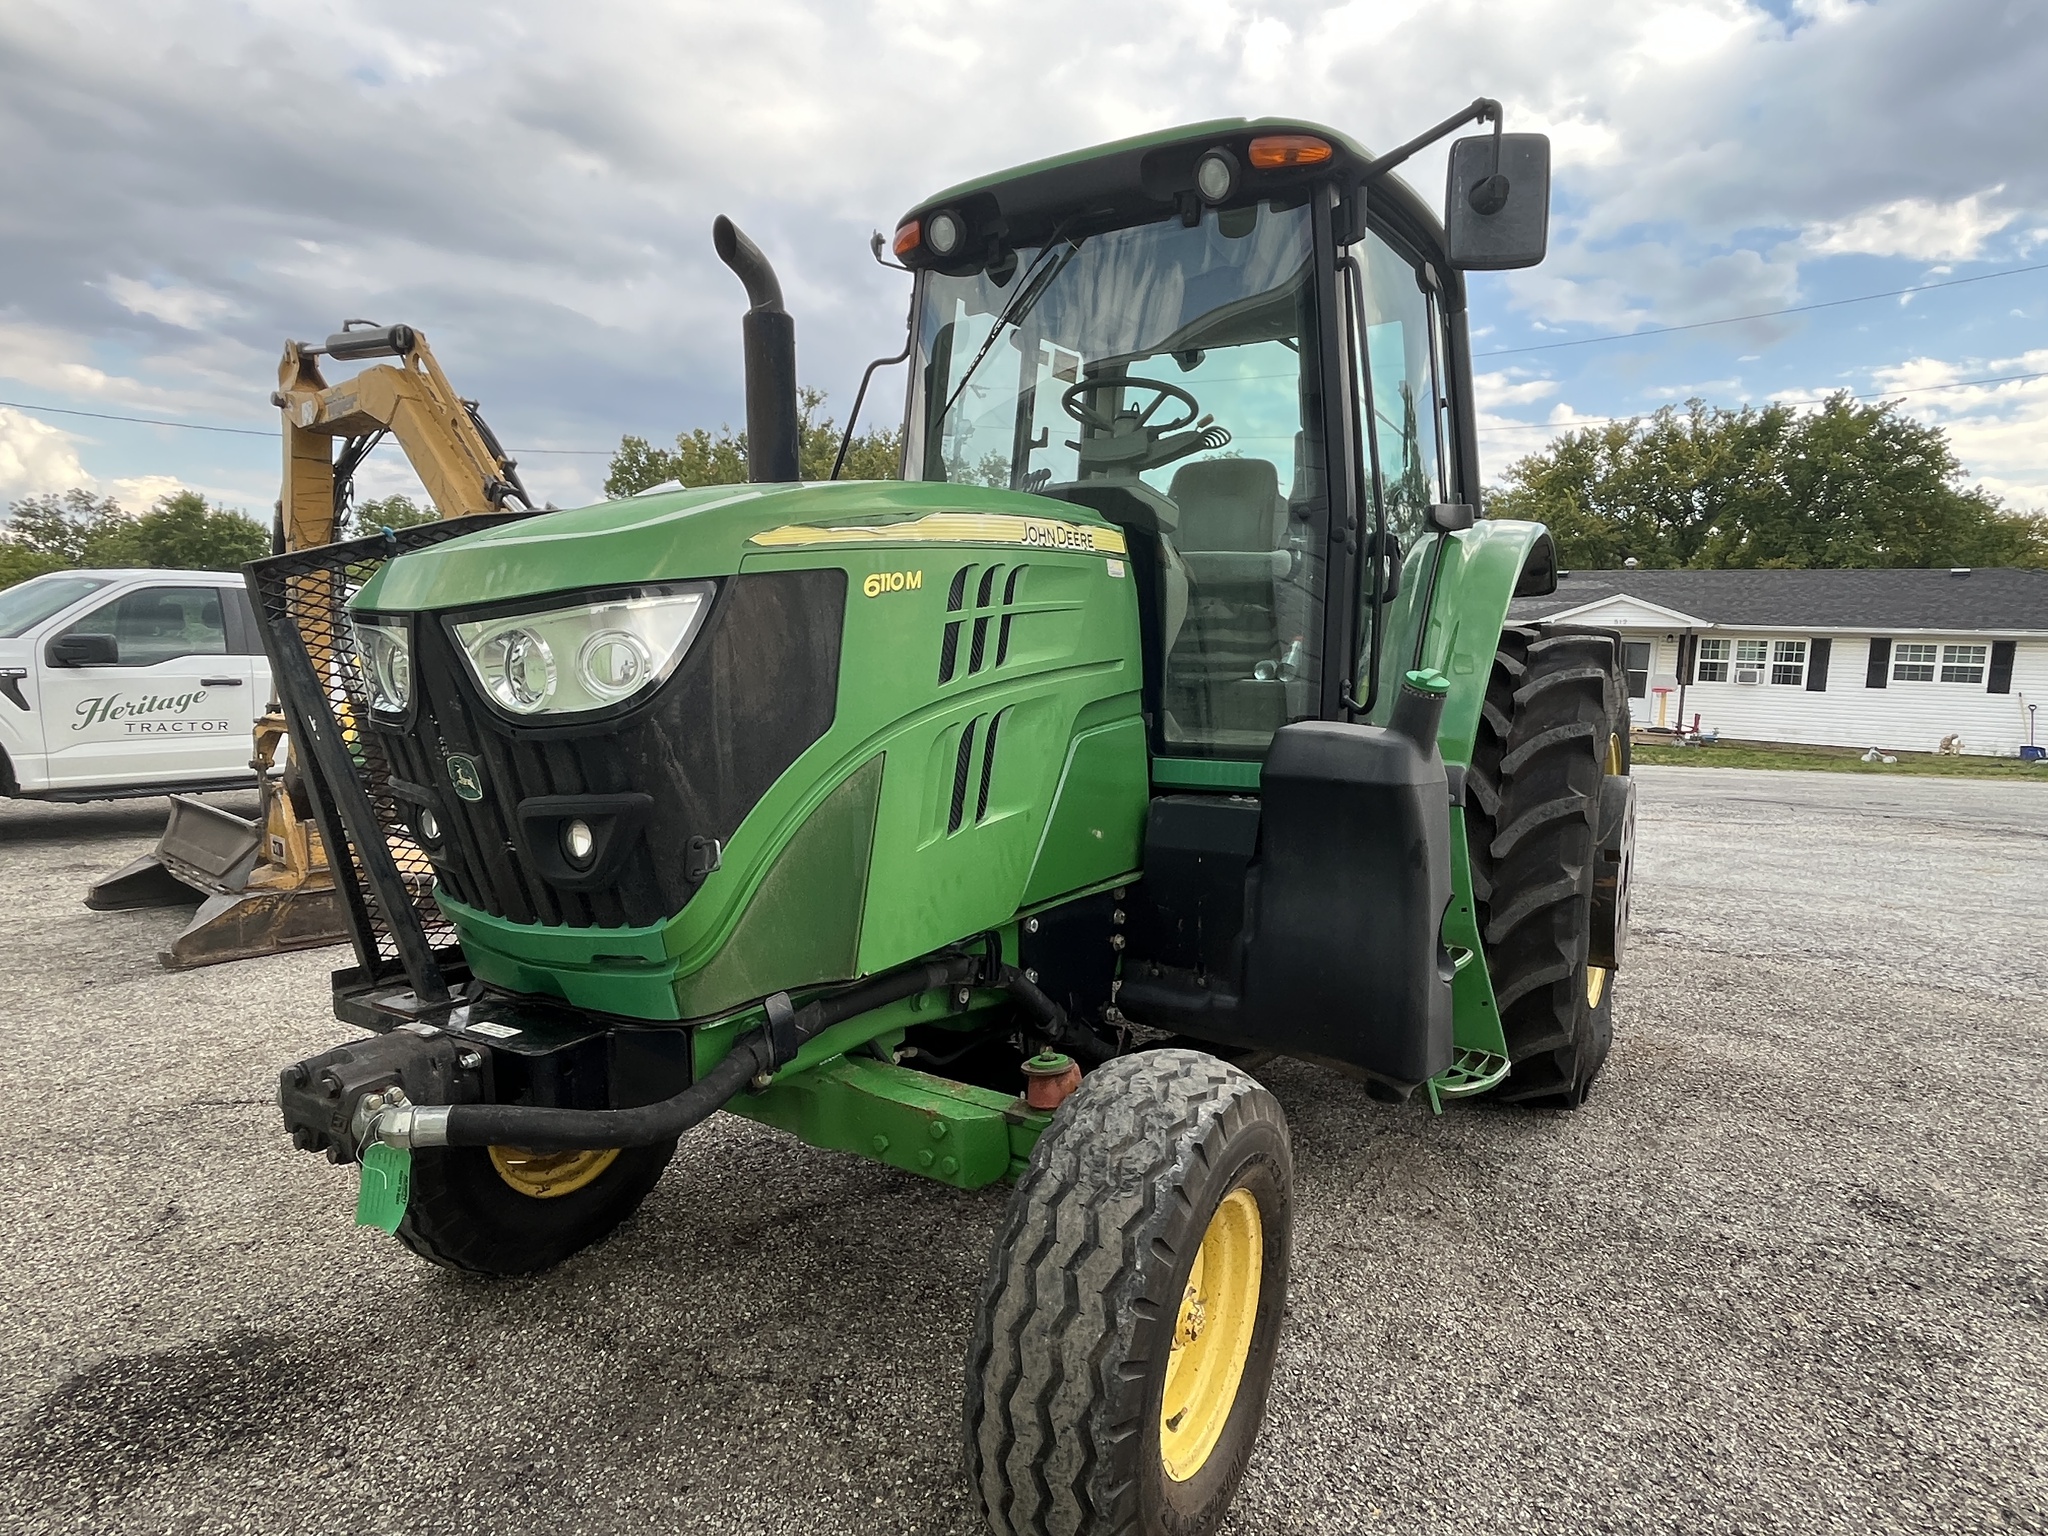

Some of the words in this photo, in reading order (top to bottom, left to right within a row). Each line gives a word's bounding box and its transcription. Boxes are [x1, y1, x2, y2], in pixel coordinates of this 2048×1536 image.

[1021, 522, 1056, 545] JOHN
[1056, 526, 1095, 549] DEERE
[71, 690, 209, 731] Heritage
[124, 721, 229, 732] TRACTOR
